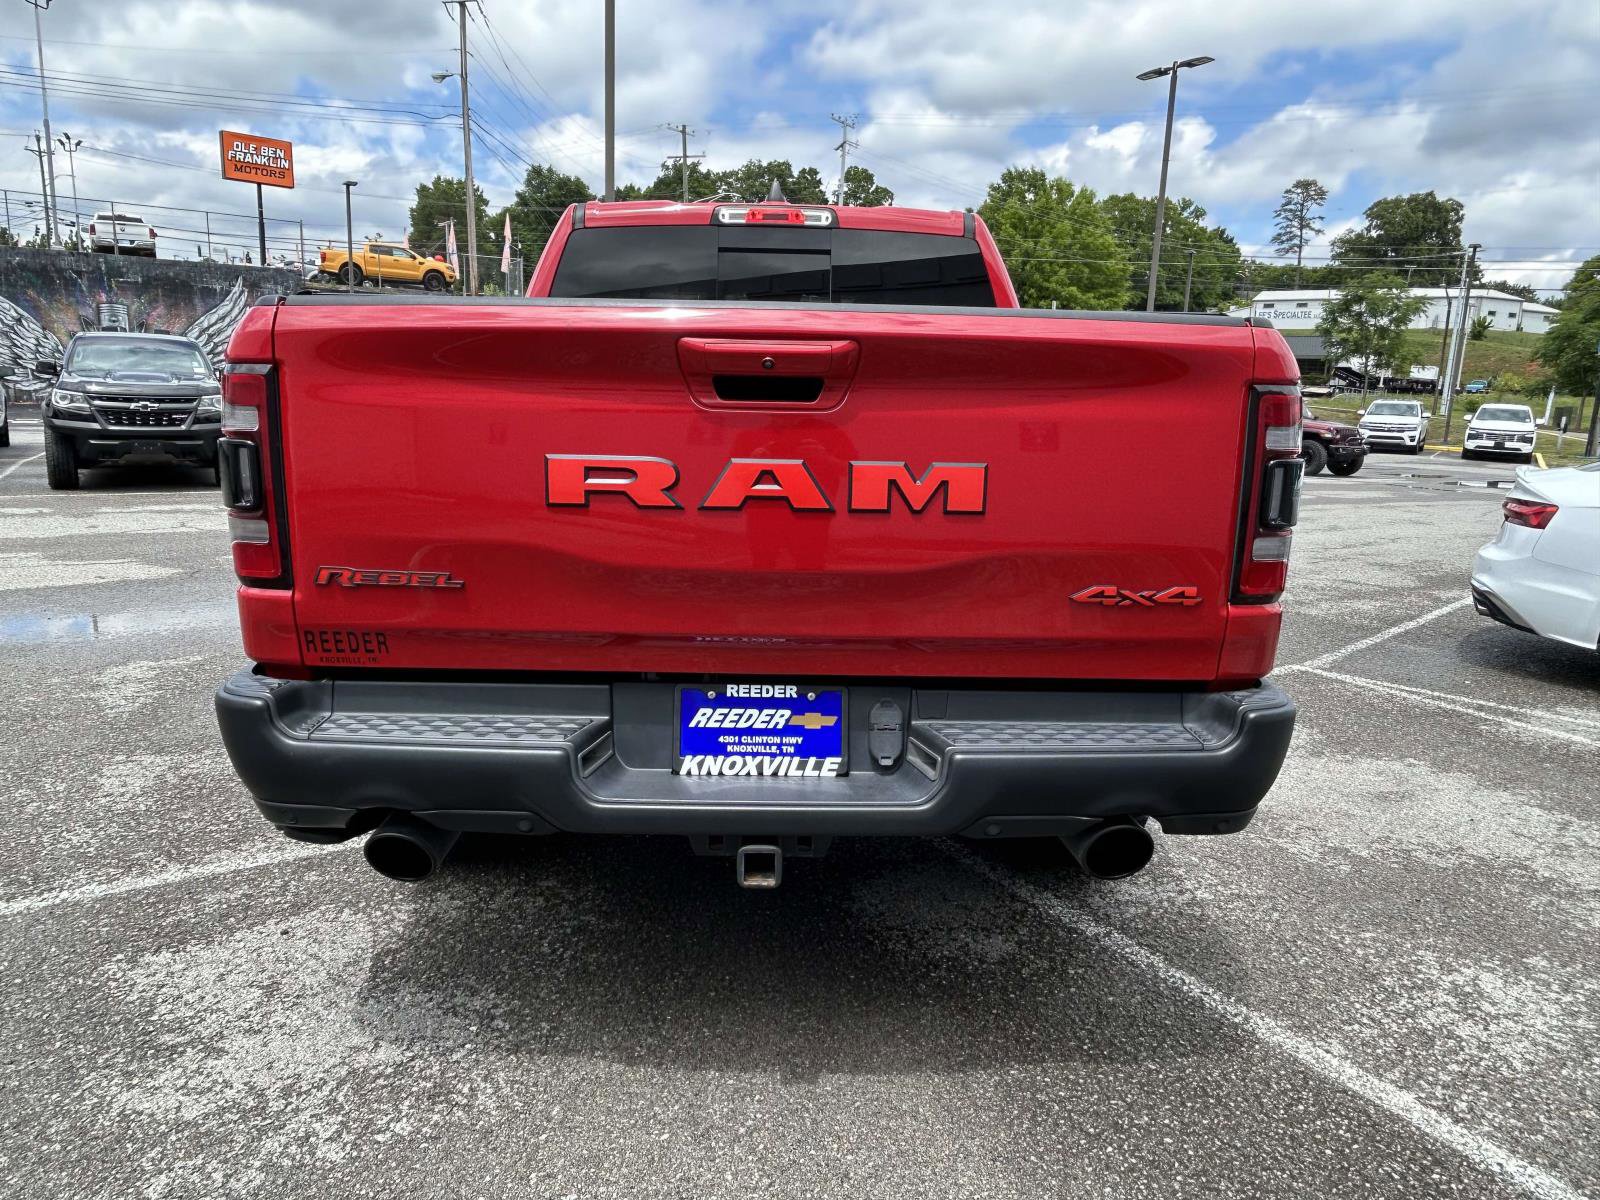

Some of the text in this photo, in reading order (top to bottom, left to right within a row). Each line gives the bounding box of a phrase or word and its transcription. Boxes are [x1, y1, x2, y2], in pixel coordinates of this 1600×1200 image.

[228, 150, 289, 169] FRANKLIN
[233, 141, 285, 159] OLE BEN
[233, 163, 286, 179] MOTORS
[544, 453, 989, 514] RAM
[314, 565, 465, 588] REBEL
[303, 630, 390, 654] REEDER
[726, 684, 798, 698] REEDER
[688, 707, 792, 729] REEDER
[718, 735, 803, 745] 4301 CLINTON HWY
[727, 745, 780, 754] KNOXVILLE,
[679, 755, 842, 777] KNOXVILLE
